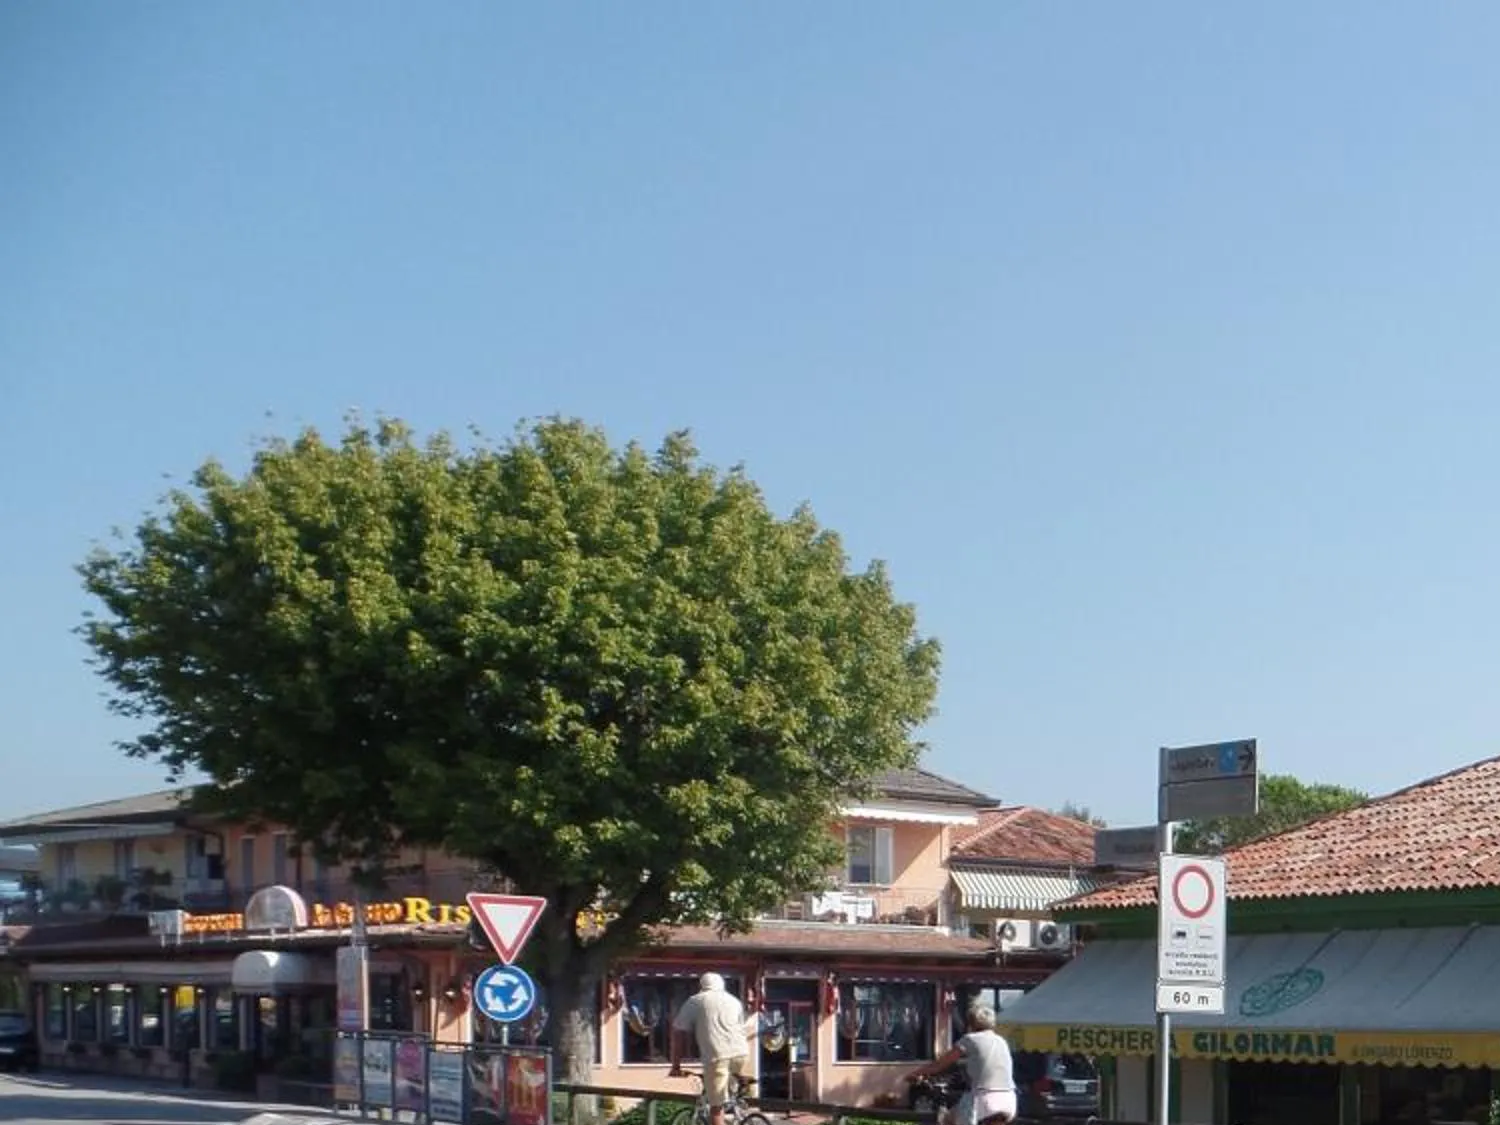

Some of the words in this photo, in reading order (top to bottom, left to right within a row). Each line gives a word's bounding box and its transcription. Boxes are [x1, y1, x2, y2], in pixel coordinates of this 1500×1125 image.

[1173, 991, 1191, 1005] 60
[1197, 996, 1209, 1005] m
[1056, 1027, 1179, 1052] PESCHERA
[1192, 1031, 1336, 1056] GILORMAR
